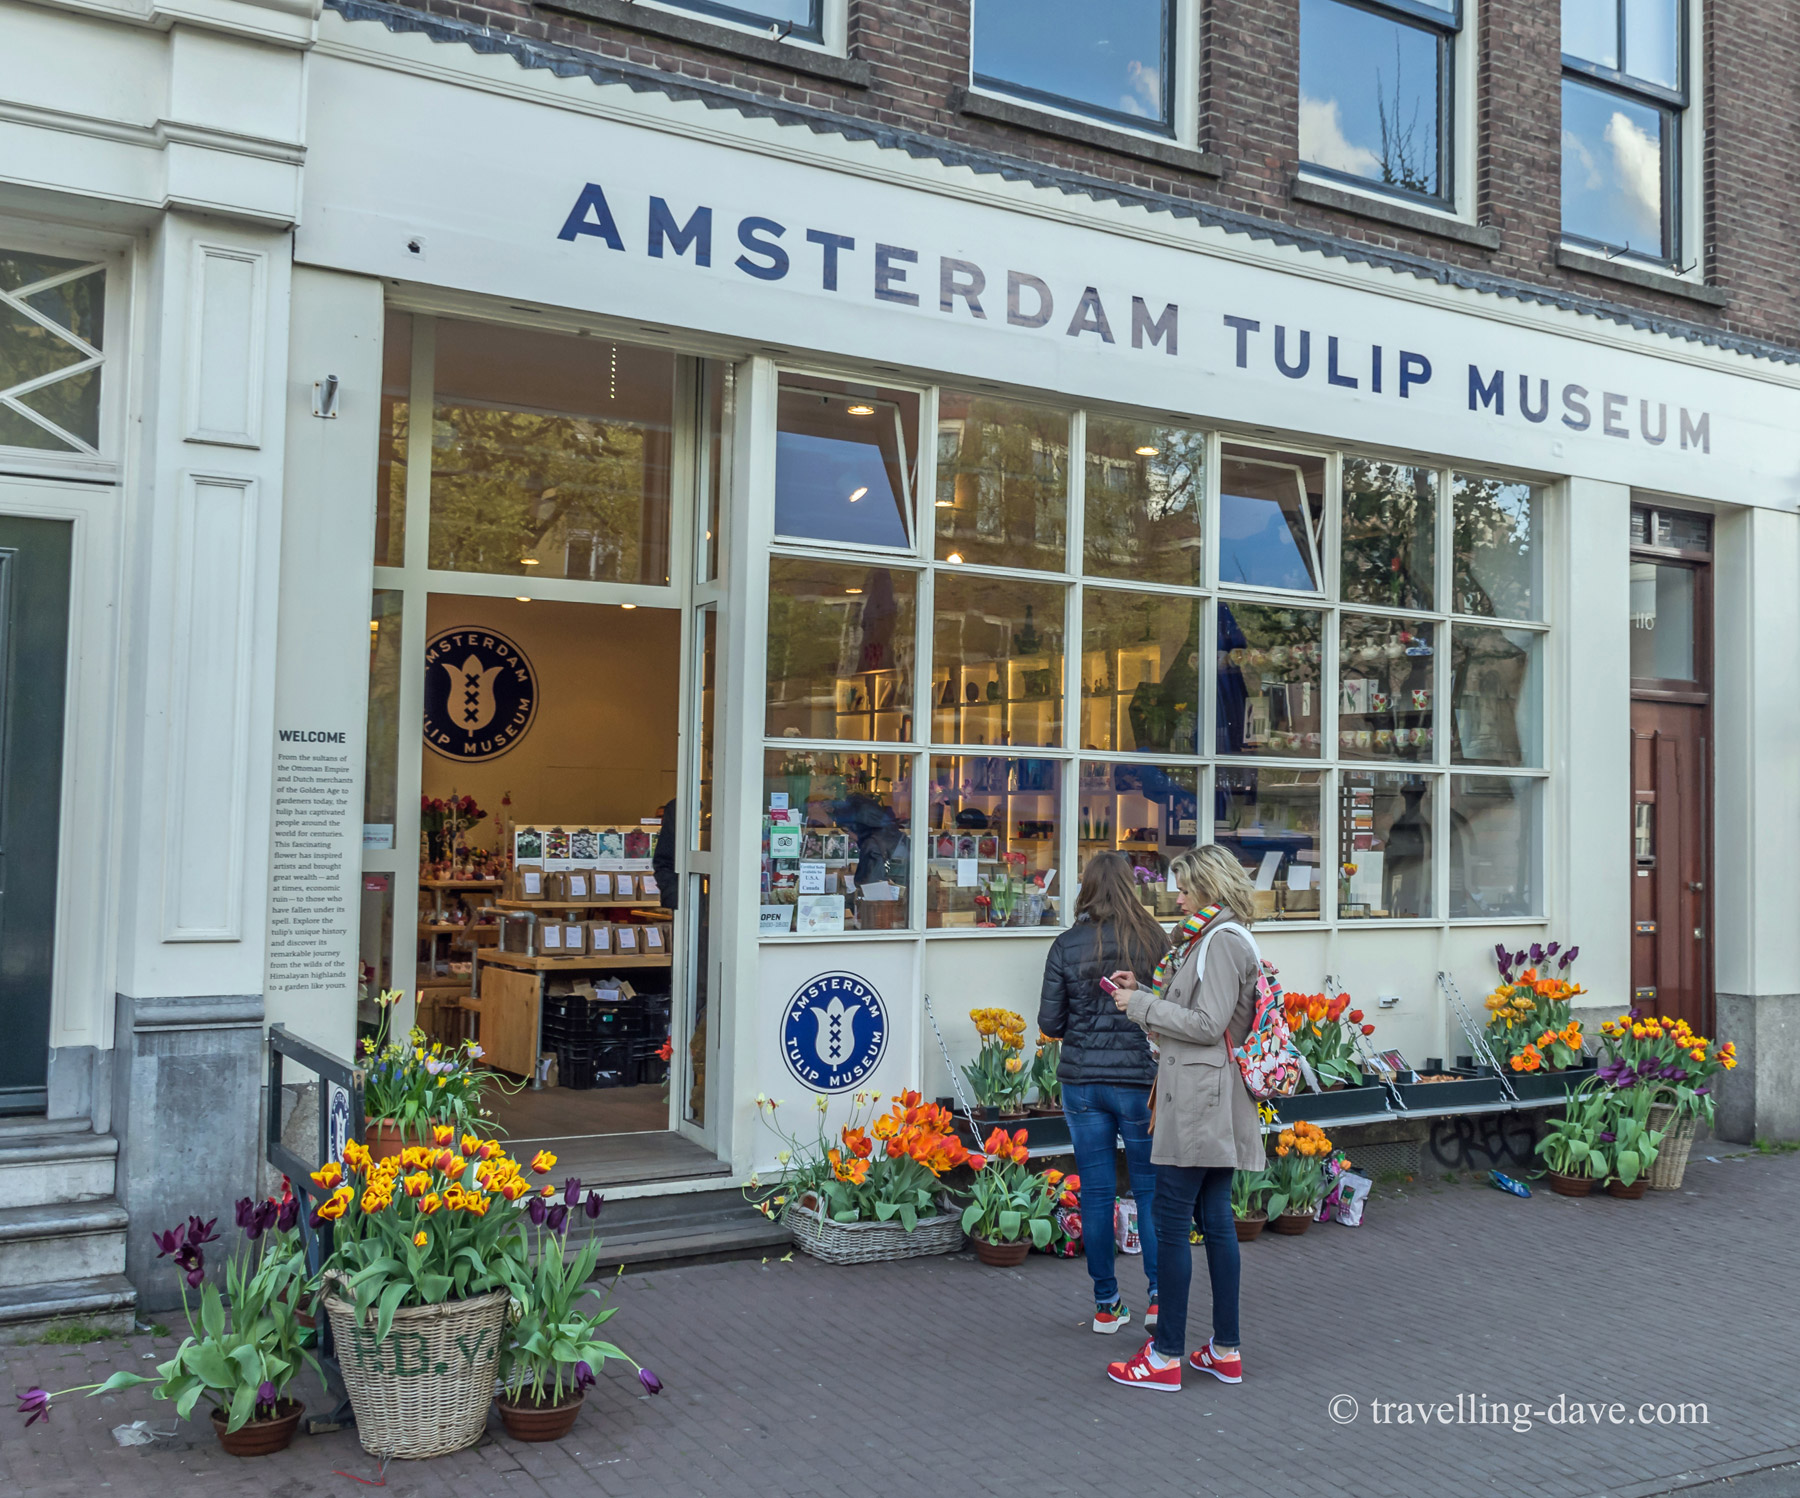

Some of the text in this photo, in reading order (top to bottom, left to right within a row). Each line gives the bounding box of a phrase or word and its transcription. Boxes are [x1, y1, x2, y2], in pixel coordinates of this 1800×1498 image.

[557, 181, 1711, 454] AMSTERDAM TULIP MUSEUM
[426, 634, 528, 682] MSTERDAM
[464, 698, 530, 753] MUSEUM
[279, 730, 346, 743] WELCOME
[325, 766, 349, 774] Empire
[292, 841, 331, 849] fascinating
[314, 863, 341, 871] brought
[760, 913, 781, 921] OPEN
[284, 983, 309, 991] garden
[791, 978, 880, 1022] AMSTERDAM
[787, 1031, 882, 1086] TULIP MUSEUM
[1200, 1352, 1213, 1367] N
[1131, 1363, 1150, 1380] N
